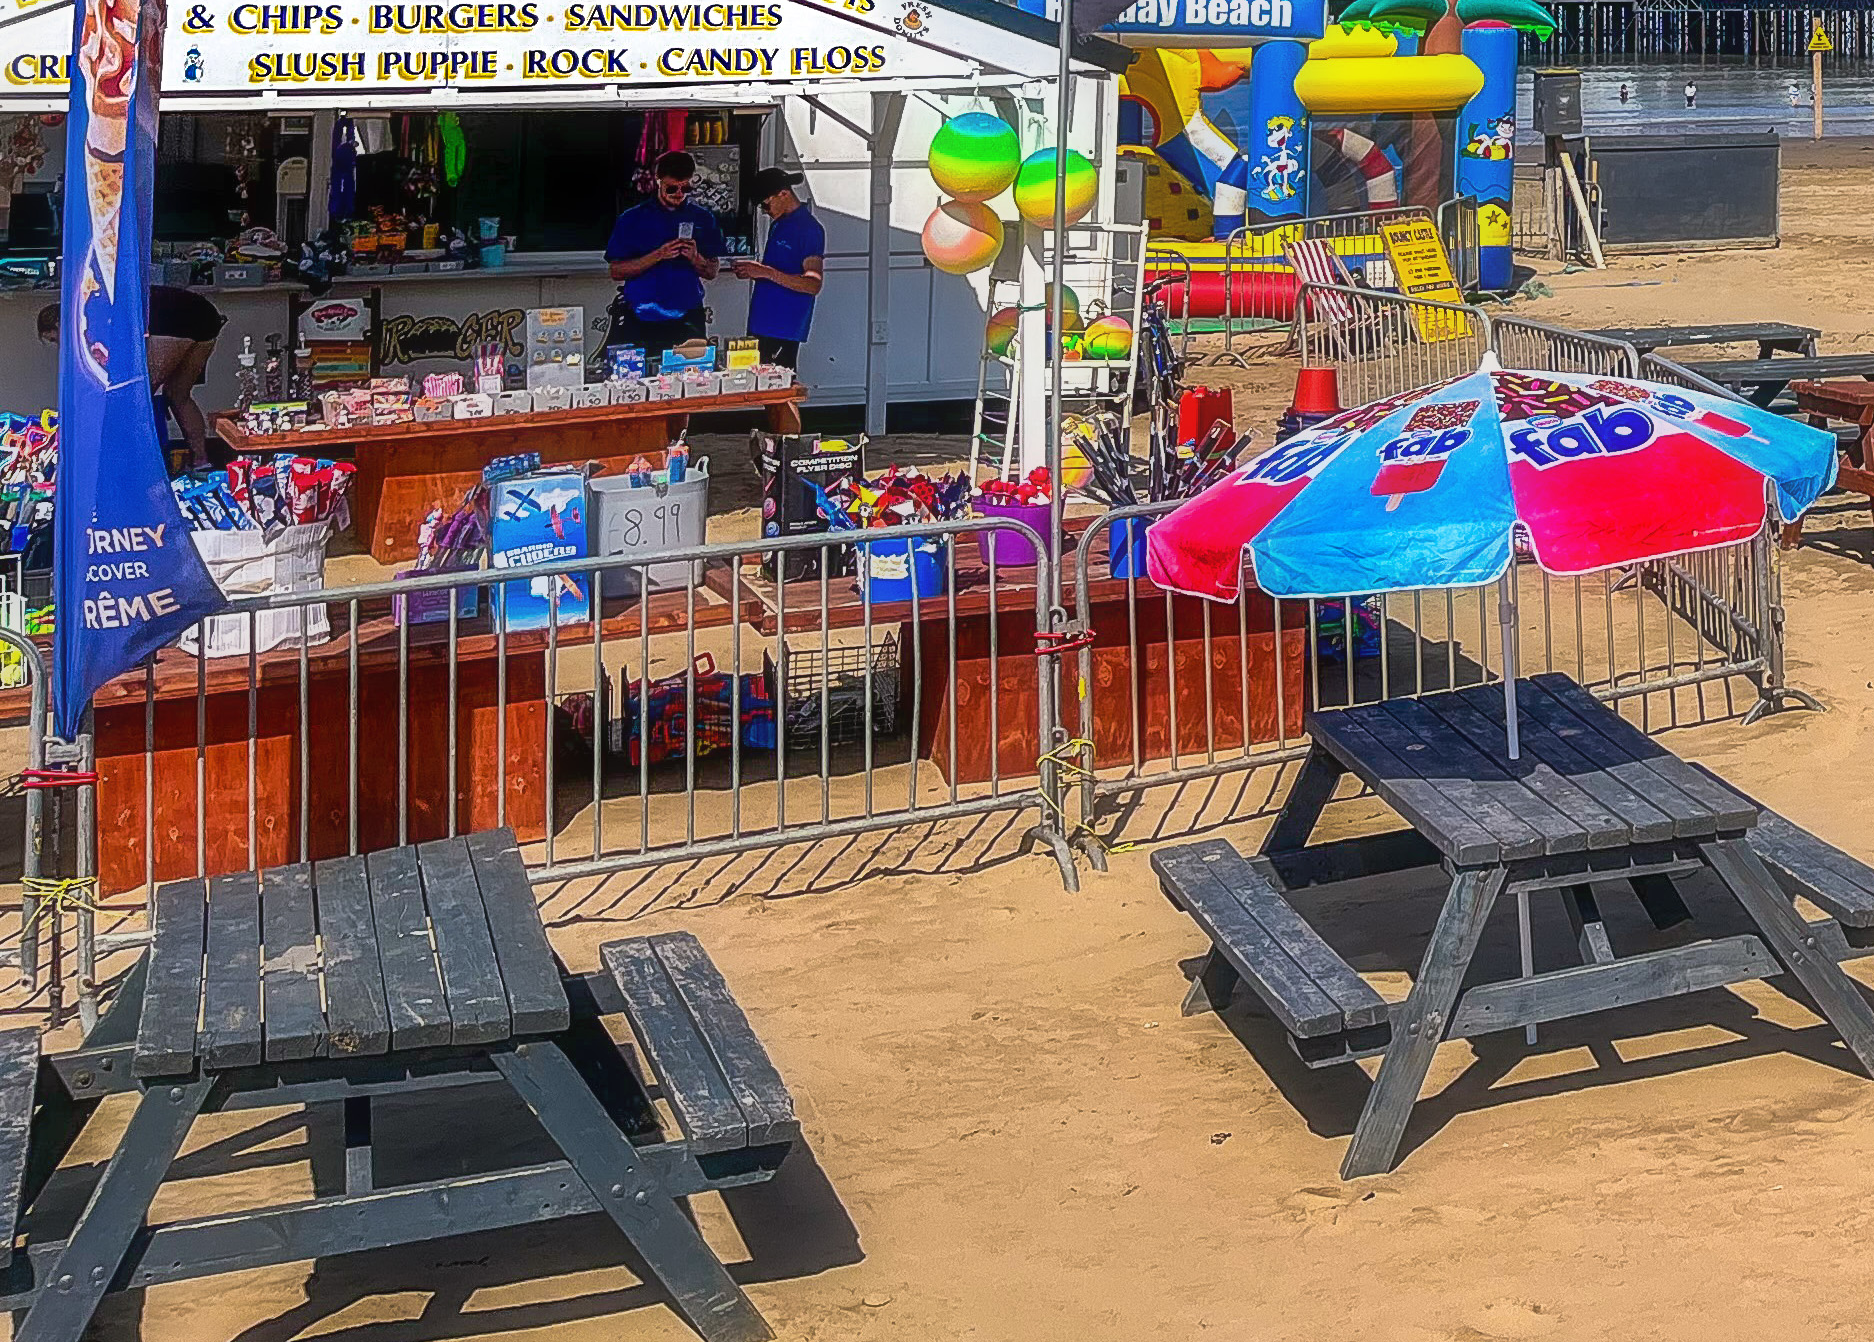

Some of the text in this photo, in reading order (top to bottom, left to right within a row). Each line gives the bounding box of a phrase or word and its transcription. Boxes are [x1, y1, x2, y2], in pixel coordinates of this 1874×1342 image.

[182, 2, 783, 34] & CHIPS BURGERS SANDWICHES
[248, 45, 887, 83] SLUSH PUPPIE ROCK CANDY FLOSS
[1379, 427, 1473, 462] fab
[1510, 407, 1655, 467] fab
[1241, 431, 1354, 483] fab
[83, 589, 180, 630] RÊME
